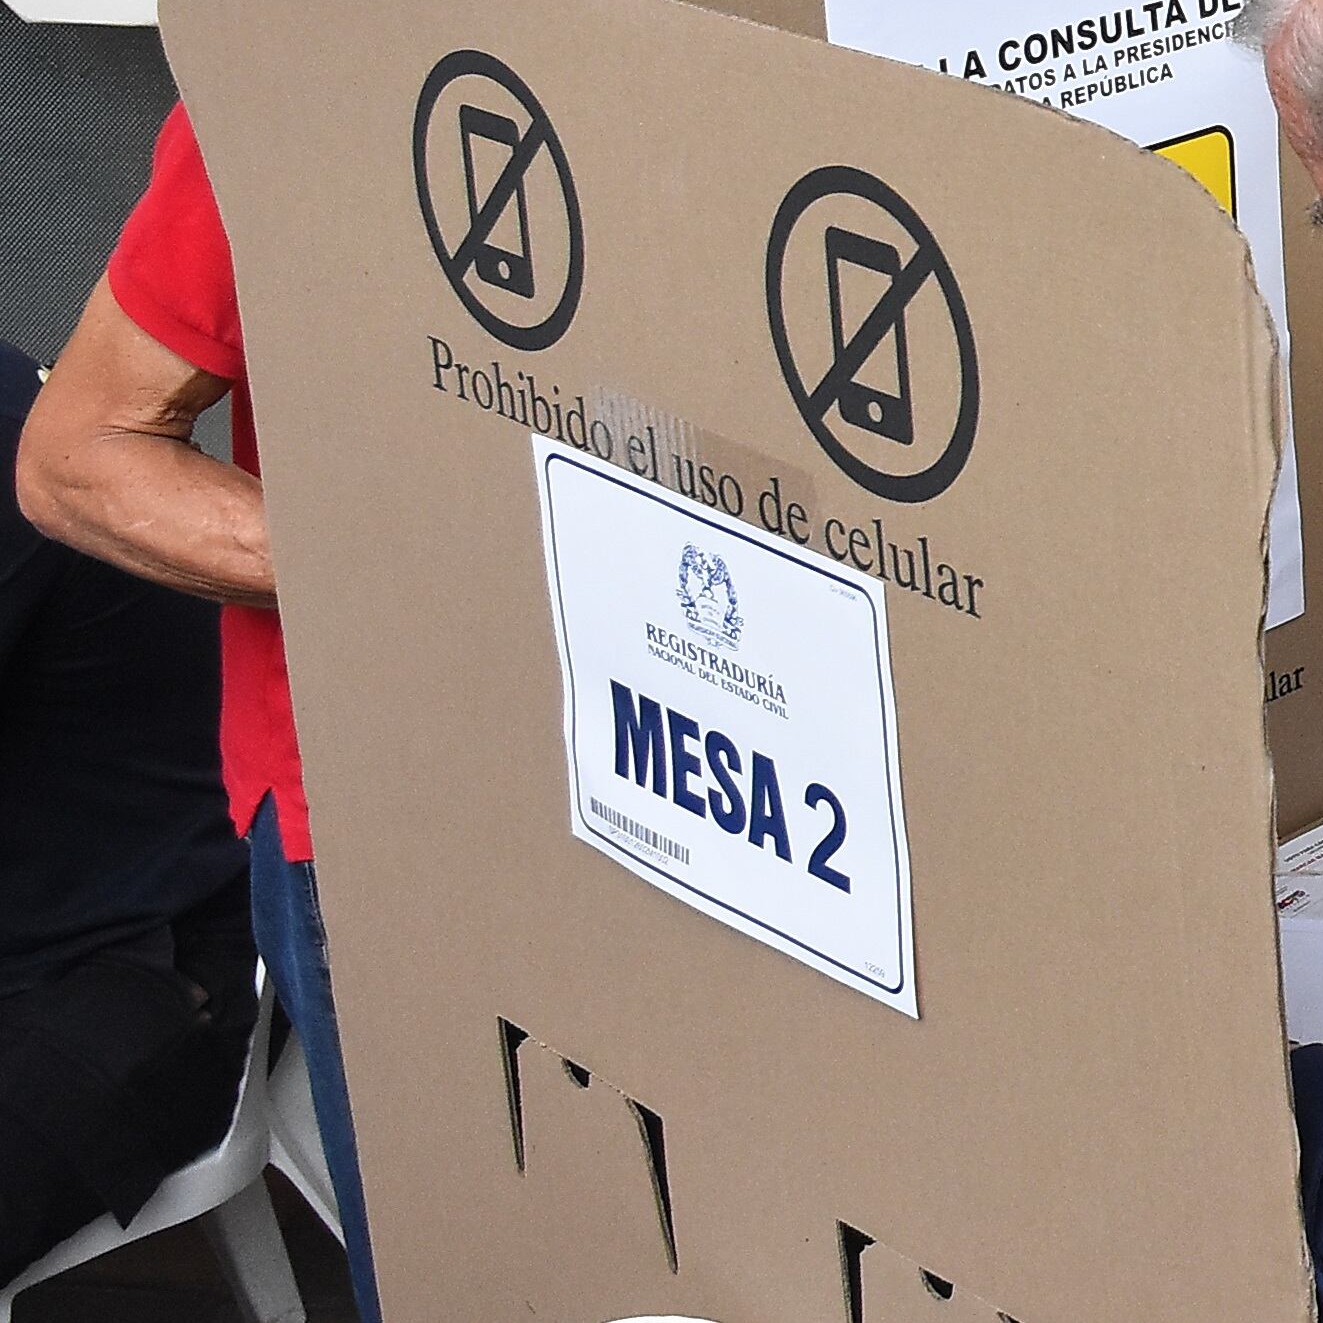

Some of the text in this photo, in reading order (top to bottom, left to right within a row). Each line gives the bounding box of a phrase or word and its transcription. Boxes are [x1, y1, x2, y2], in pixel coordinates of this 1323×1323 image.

[991, 21, 1232, 95] ATOS A LA PRESIDENCI
[1060, 62, 1174, 109] REPÚBLICA
[428, 335, 984, 620] Prohibido el uso de celular
[646, 622, 787, 705] REGISTRADURÍA
[648, 643, 789, 720] NACIONAL DEL ESTADO CIVIL
[609, 677, 851, 894] MESA 2
